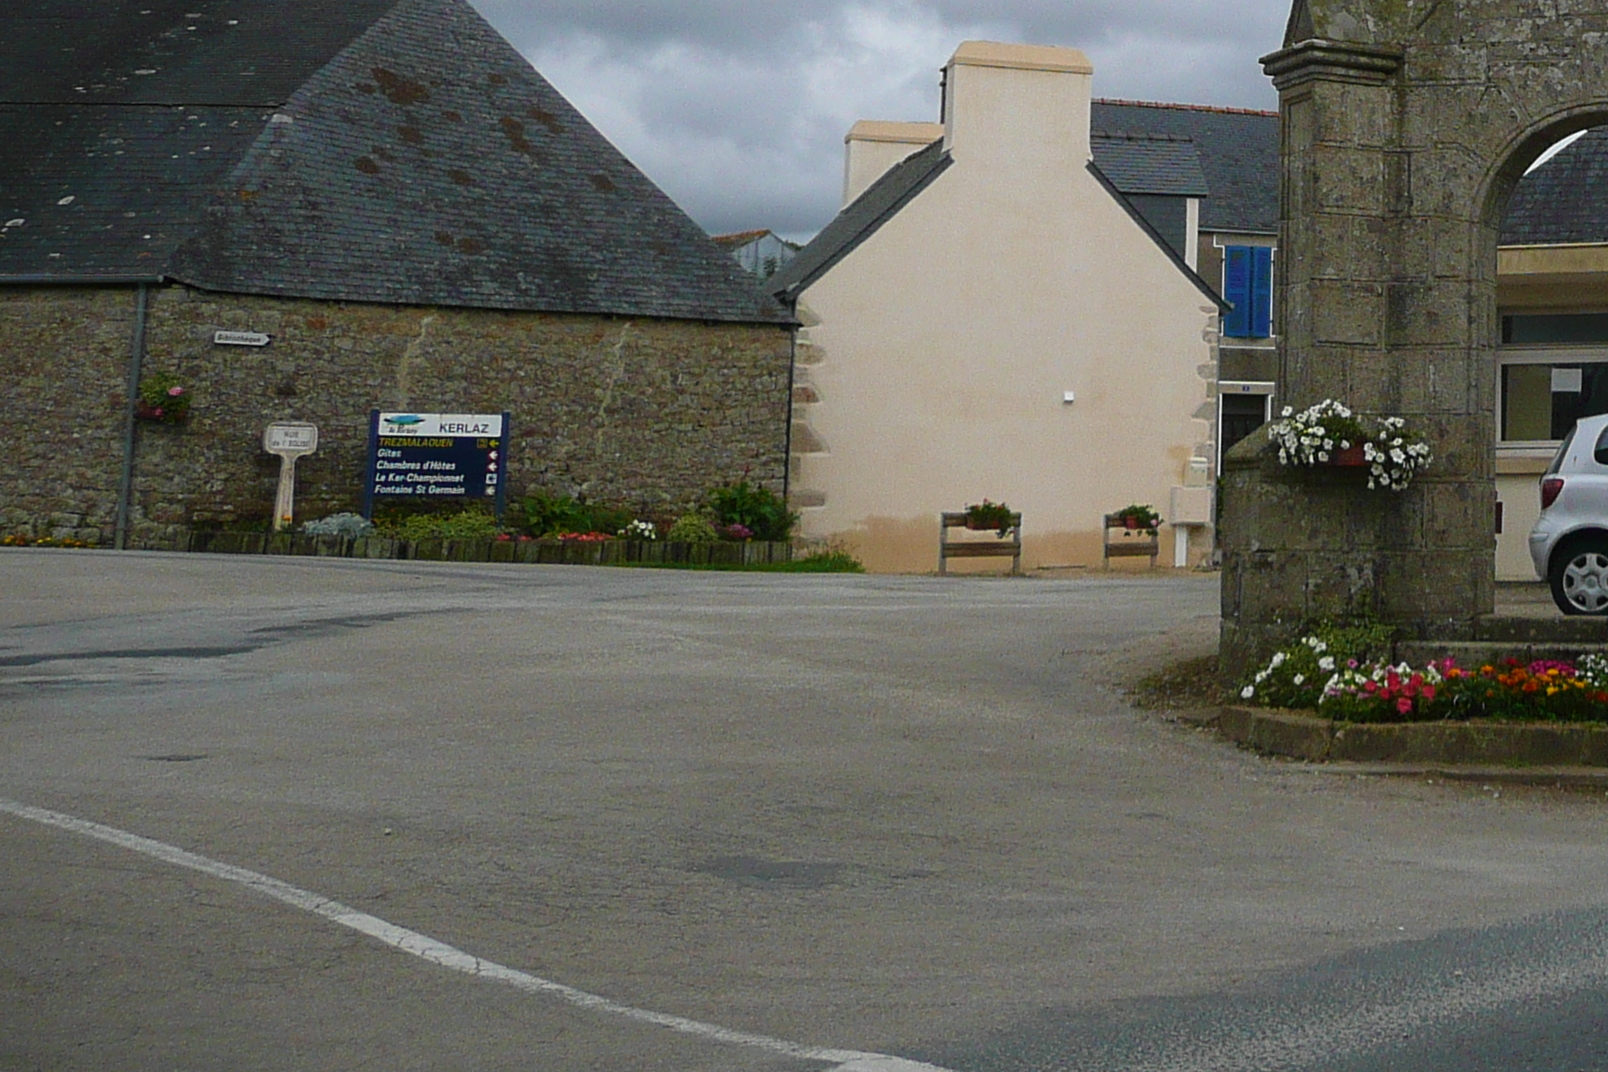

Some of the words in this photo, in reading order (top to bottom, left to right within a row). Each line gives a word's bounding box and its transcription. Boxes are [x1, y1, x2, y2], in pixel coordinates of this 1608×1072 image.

[439, 423, 489, 434] KERLAZ
[379, 438, 454, 447] TREZMALAOUEN
[376, 460, 420, 469] Chambres
[422, 460, 456, 470] d'Hôtes
[375, 473, 386, 482] Le
[374, 484, 413, 494] Fontaine
[415, 484, 427, 494] St
[428, 485, 465, 494] Germain
